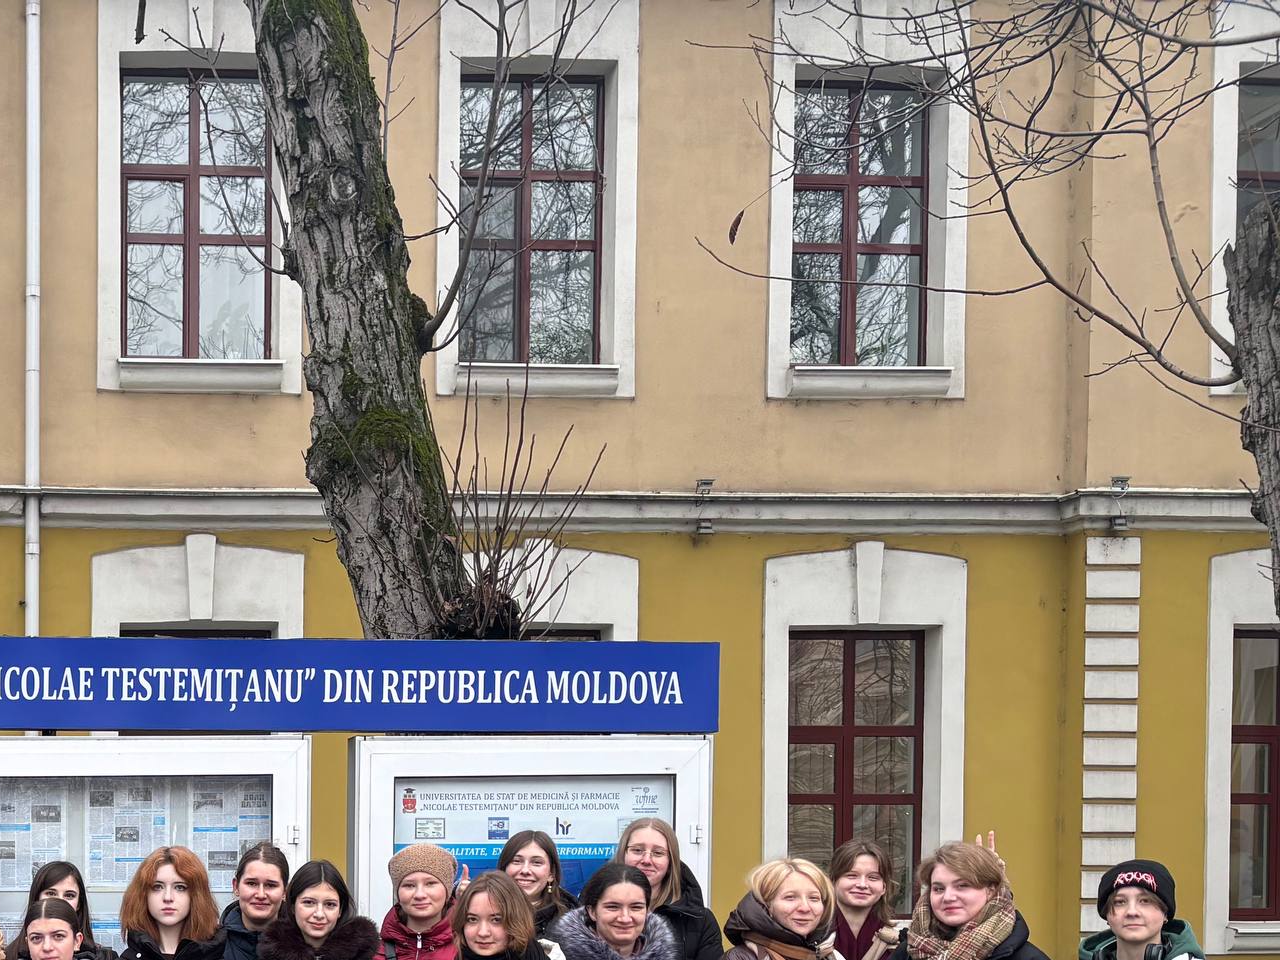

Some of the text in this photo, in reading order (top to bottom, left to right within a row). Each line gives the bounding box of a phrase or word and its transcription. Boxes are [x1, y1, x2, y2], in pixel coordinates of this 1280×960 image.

[322, 669, 374, 703] DIN
[381, 669, 540, 704] REPUBLICA
[546, 670, 684, 705] MOLDOVA
[419, 792, 482, 801] UNIVERSITATEA
[483, 792, 495, 801] DE
[496, 792, 516, 801] STAT
[517, 792, 529, 801] DE
[530, 791, 570, 801] MEDICINĂ
[580, 792, 621, 801] FARMACIE
[519, 803, 534, 811] DIN
[536, 803, 580, 811] REPUBLICA
[581, 803, 620, 811] MOLDOVA
